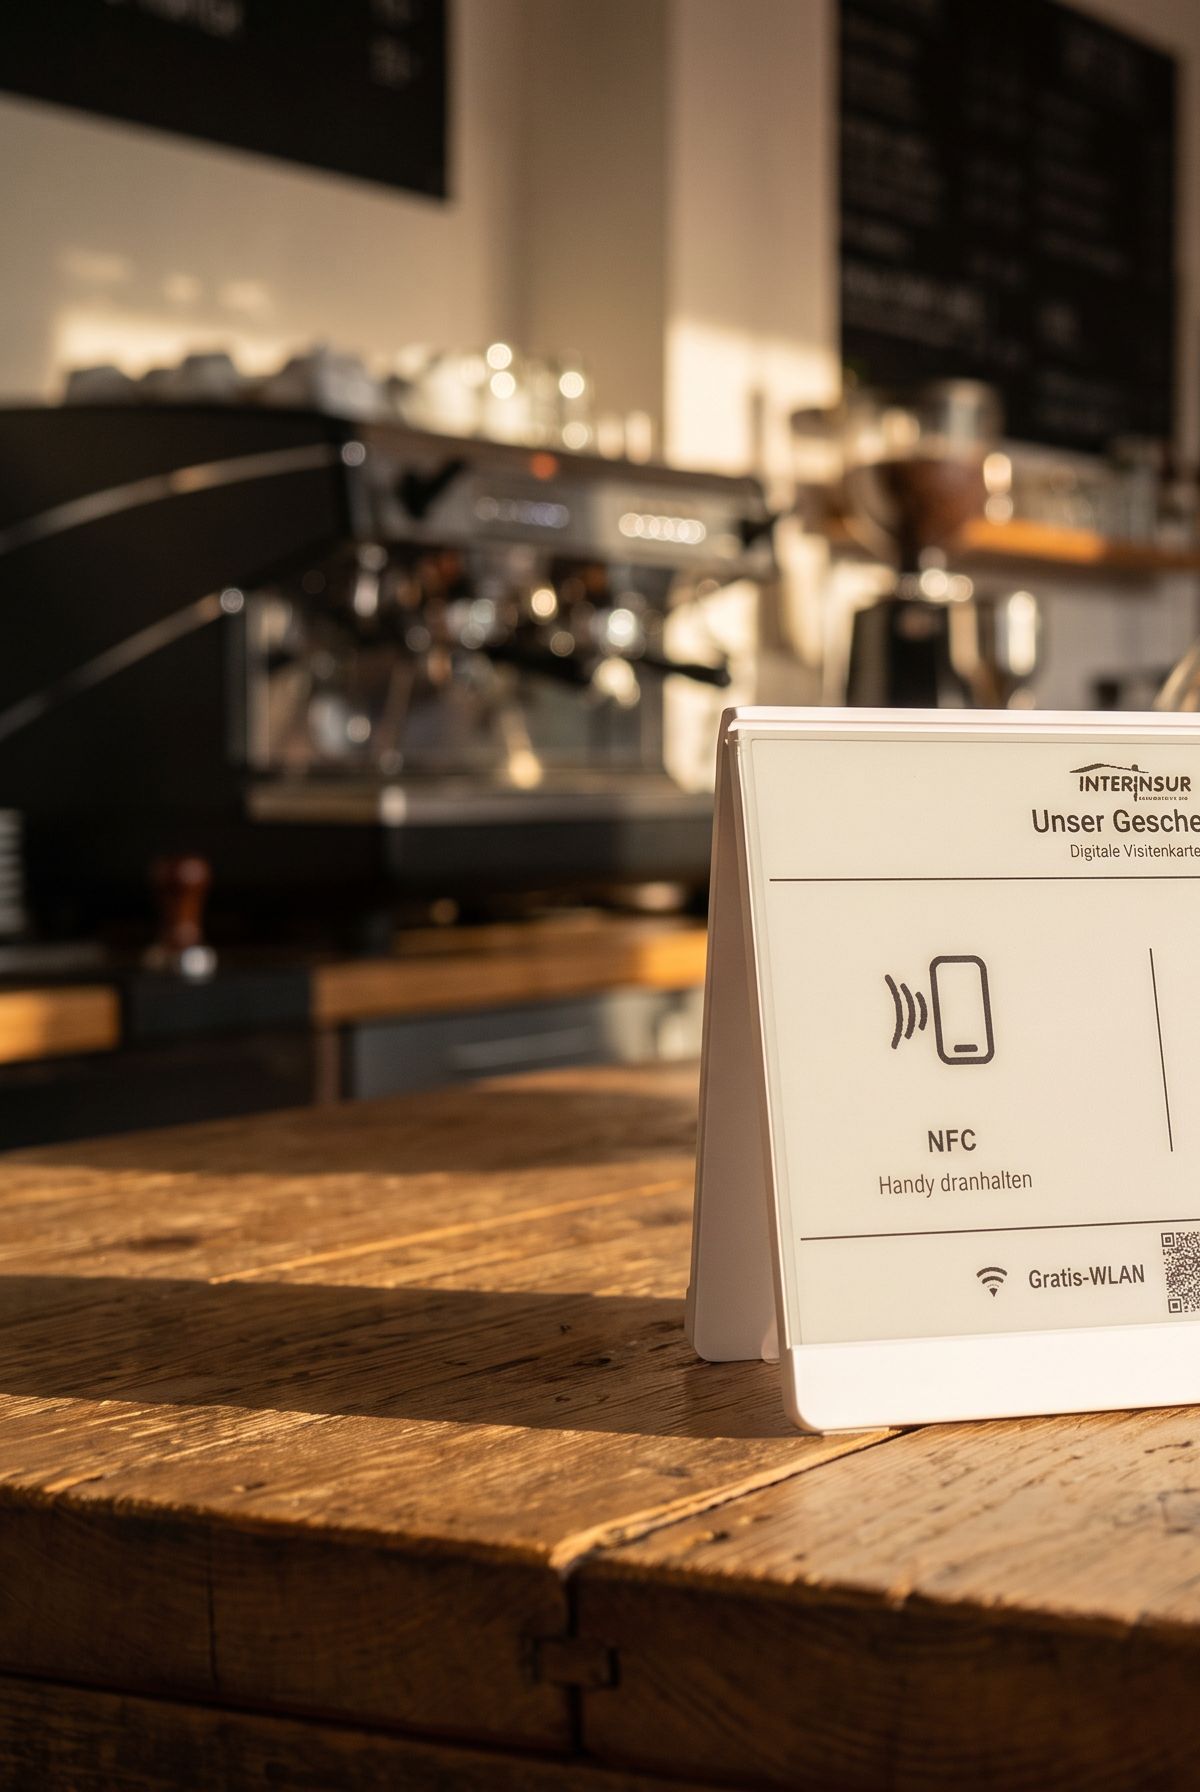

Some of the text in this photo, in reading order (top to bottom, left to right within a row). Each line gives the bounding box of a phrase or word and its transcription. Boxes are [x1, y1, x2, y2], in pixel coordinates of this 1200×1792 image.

[1079, 775, 1191, 795] INTERINSUR
[1031, 809, 1104, 833] Unser
[1070, 843, 1121, 861] Digitale
[927, 1128, 977, 1153] NFC
[879, 1169, 1033, 1199] Handy dranhalten
[1028, 1263, 1145, 1289] Gratis-WLAN
